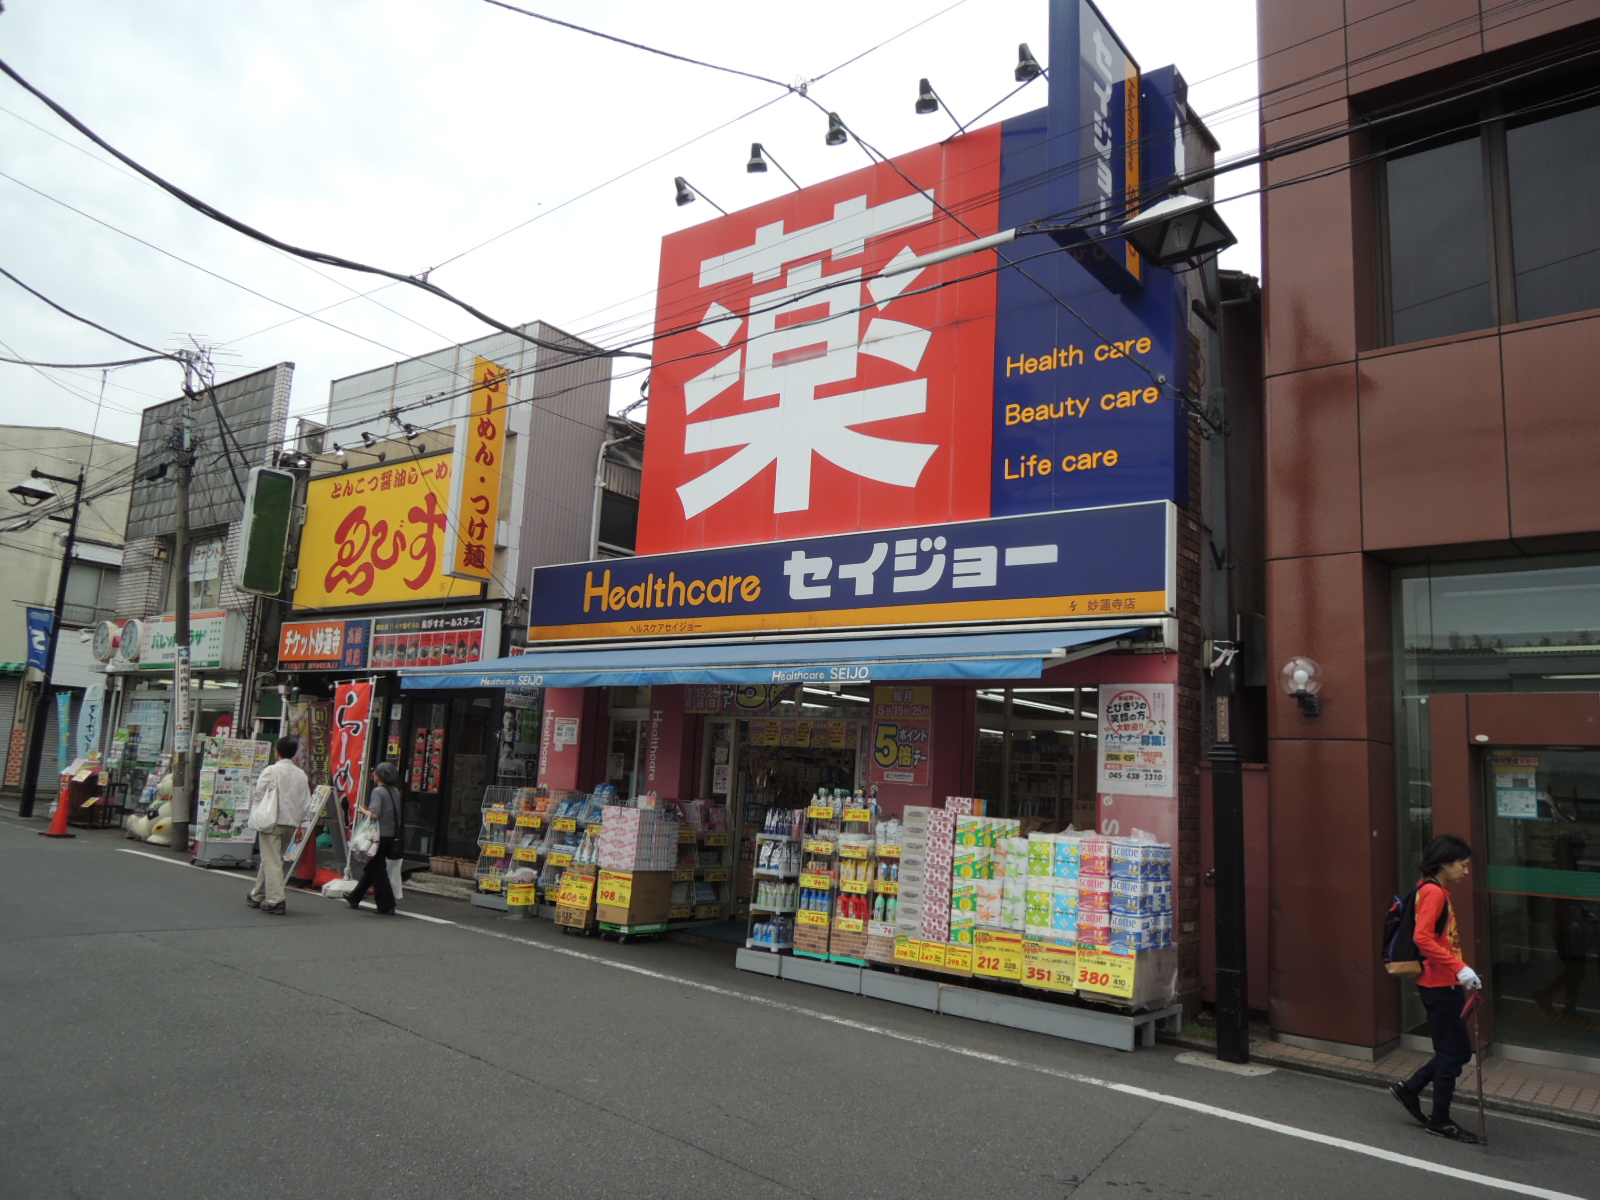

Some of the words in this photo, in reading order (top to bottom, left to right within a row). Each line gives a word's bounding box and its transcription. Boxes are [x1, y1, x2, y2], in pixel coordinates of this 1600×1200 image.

[1092, 28, 1113, 236] セイジョー
[1126, 77, 1137, 173] Healthcare
[675, 188, 939, 521] 薬
[1006, 345, 1084, 378] Health
[1094, 335, 1153, 362] care
[1004, 394, 1091, 426] Beauty
[1099, 386, 1160, 411] care
[1004, 452, 1053, 480] Life
[1061, 449, 1119, 473] care
[583, 568, 762, 614] Healthcare
[783, 536, 1059, 601] セイジョー
[1086, 597, 1137, 614] 妙蓮寺店
[627, 620, 703, 636] ヘルスケアセイジョー
[284, 626, 341, 657] チケット妙蓮寺
[480, 676, 516, 687] Healthcare
[518, 675, 544, 687] SEIJO
[772, 669, 825, 682] Healthcare
[829, 665, 869, 680] SEIJO
[893, 690, 913, 702] 毎月
[878, 705, 892, 716] 5日
[894, 705, 910, 716] 15日
[912, 706, 929, 717] 25日
[1106, 701, 1147, 714] とびきりの
[540, 709, 555, 775] Healthcare
[899, 728, 928, 743] ポイント
[648, 710, 663, 781] Healthcare
[1113, 847, 1139, 858] scottie
[1112, 880, 1138, 893] scottie
[560, 892, 578, 903] 406
[600, 890, 617, 901] 198
[1111, 915, 1136, 928] scottie
[977, 956, 1001, 971] 212
[1026, 966, 1052, 982] 351
[1056, 974, 1071, 982] 379
[1078, 970, 1110, 987] 380
[1113, 978, 1126, 986] 410
